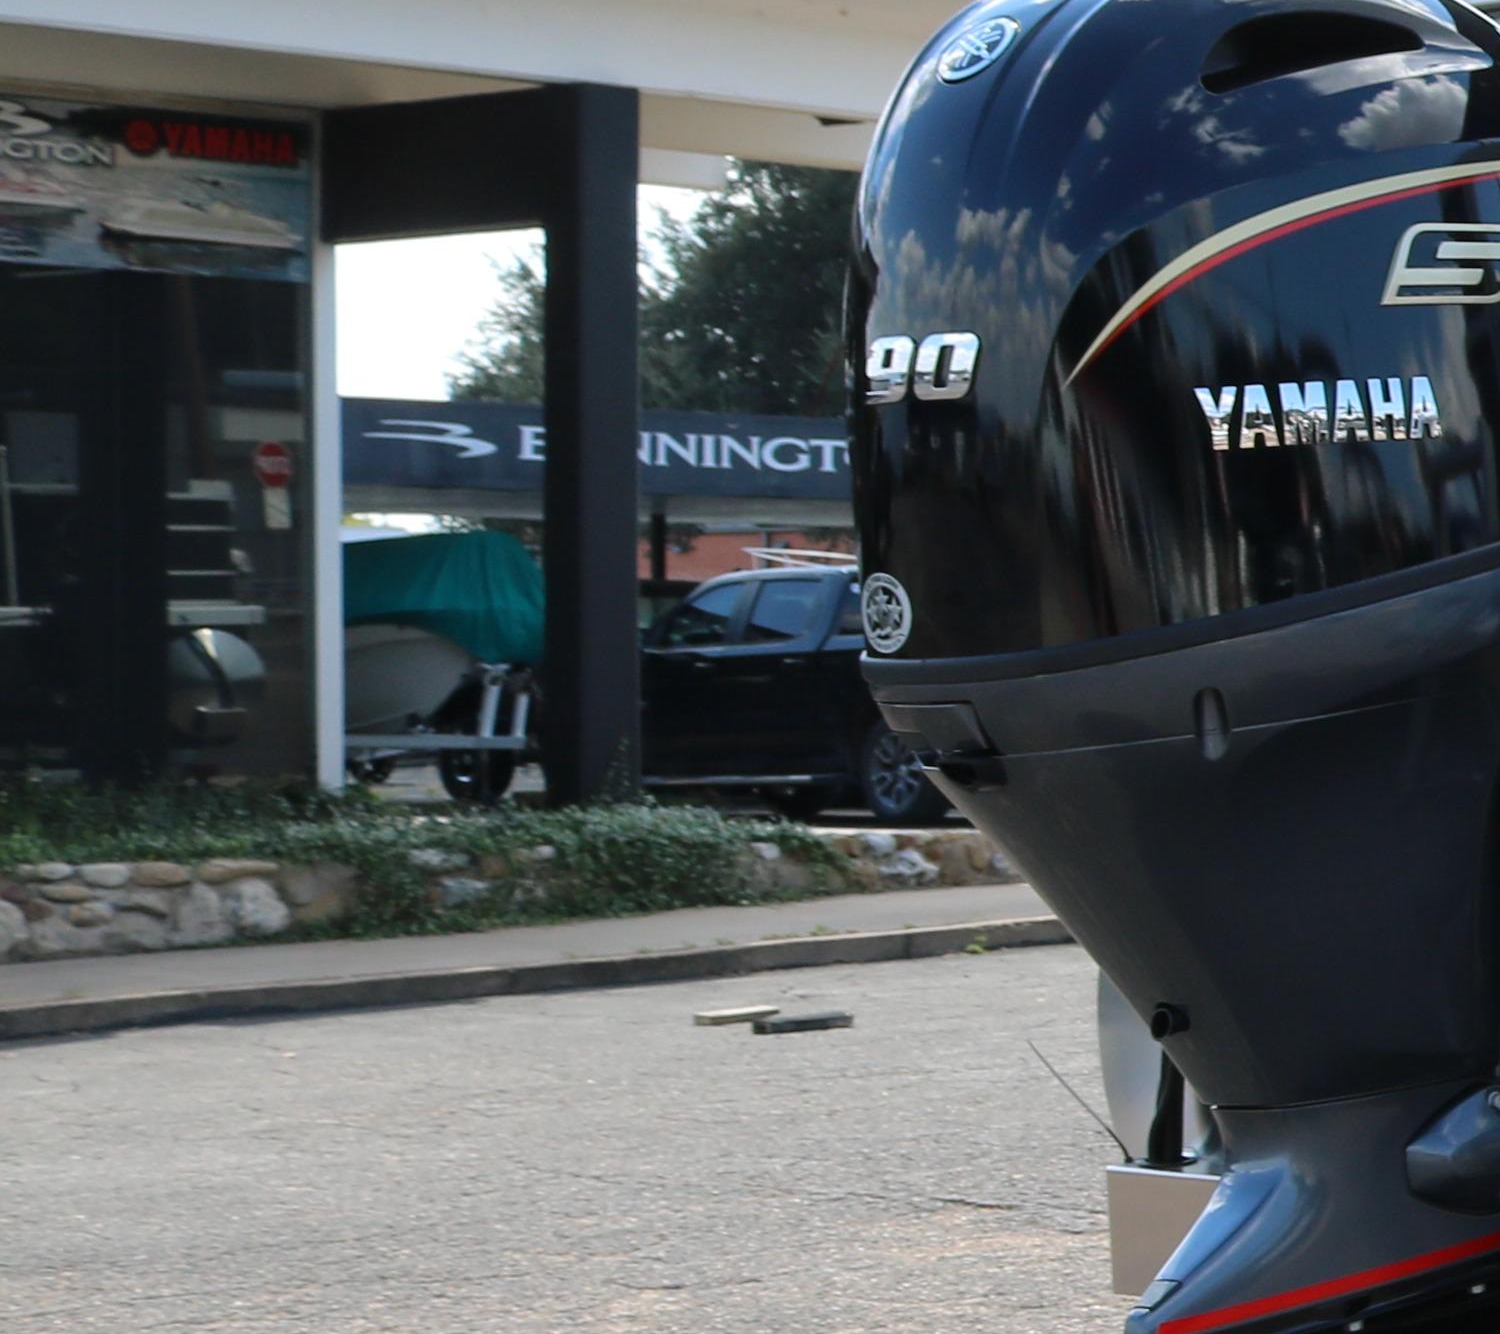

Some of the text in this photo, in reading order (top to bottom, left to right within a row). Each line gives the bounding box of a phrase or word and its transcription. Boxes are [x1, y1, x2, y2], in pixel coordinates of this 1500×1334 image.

[0, 137, 115, 166] GTON
[163, 122, 299, 167] YAMAHA
[865, 331, 980, 405] 90
[1193, 375, 1443, 451] YAMAHA
